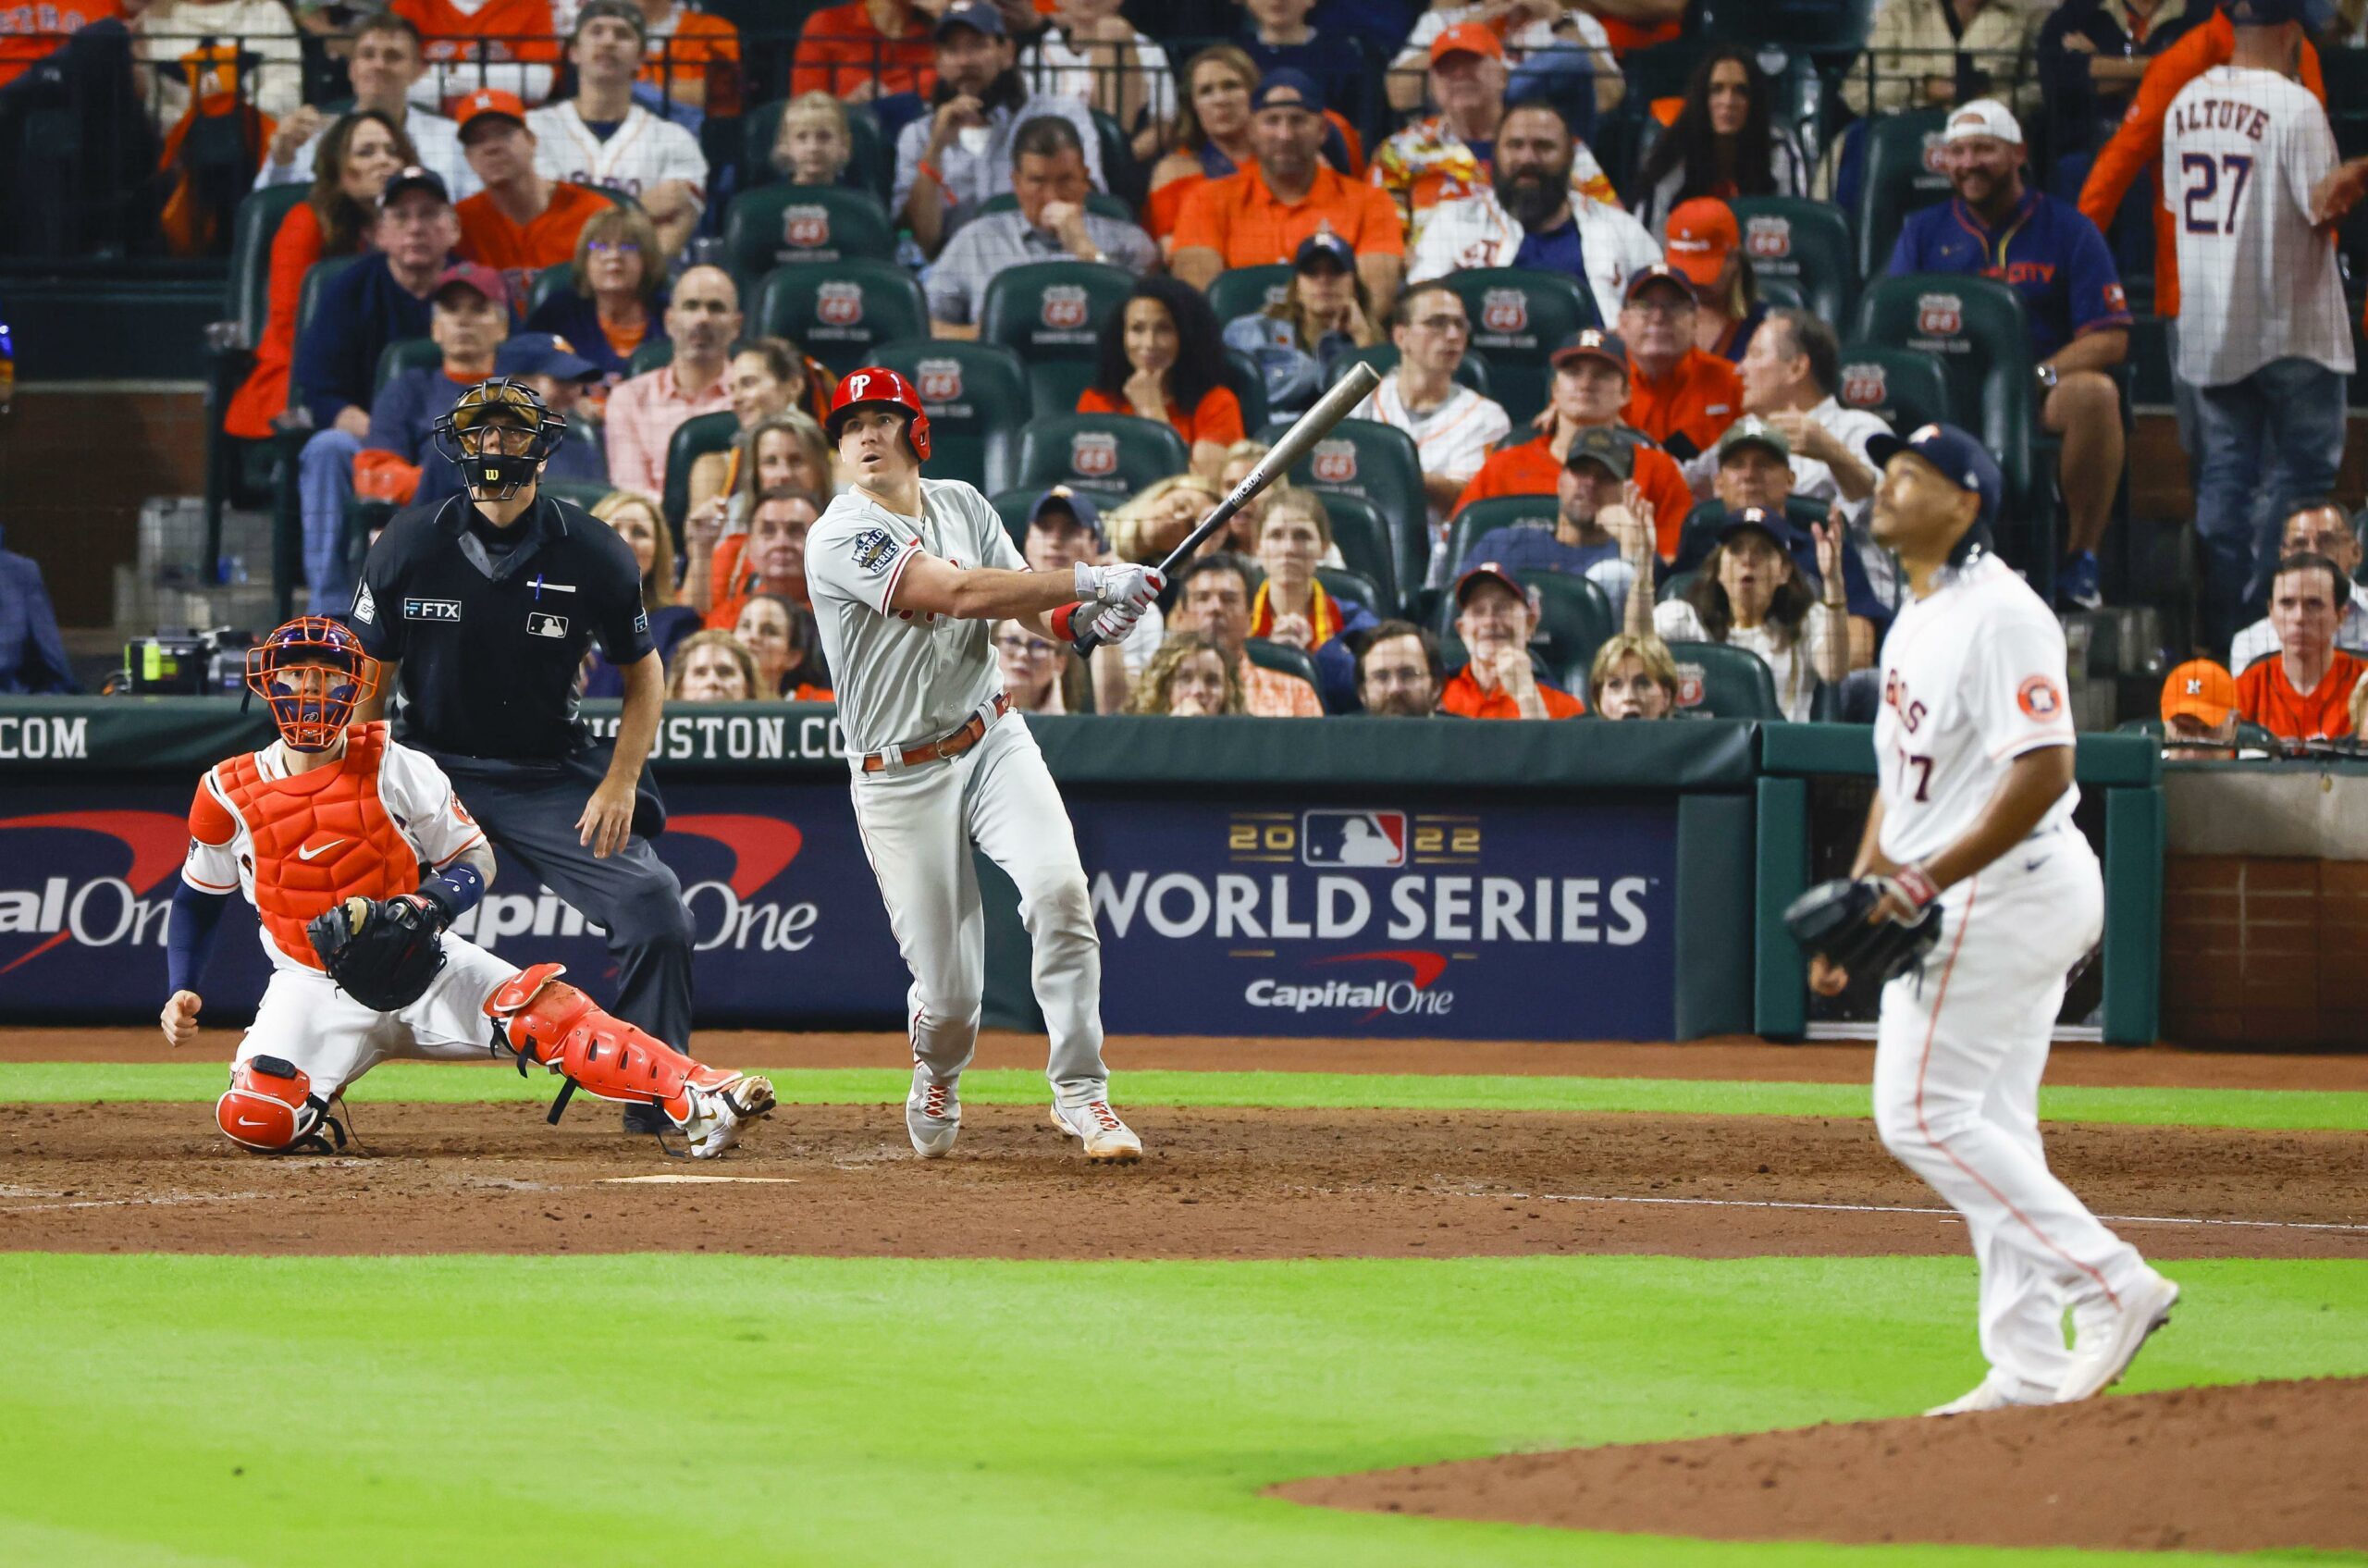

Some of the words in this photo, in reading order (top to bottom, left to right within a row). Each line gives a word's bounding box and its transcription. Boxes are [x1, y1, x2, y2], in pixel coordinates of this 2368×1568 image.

[2176, 98, 2270, 142] ALTUVE
[2181, 152, 2254, 234] 27
[850, 374, 871, 402] P
[852, 529, 885, 562] WORLD
[870, 543, 899, 573] SERIES
[422, 602, 459, 618] FTX
[1229, 825, 1295, 850] 20
[1414, 827, 1480, 852] 22
[1090, 871, 1373, 939] WORLD
[1388, 875, 1648, 945] SERIES
